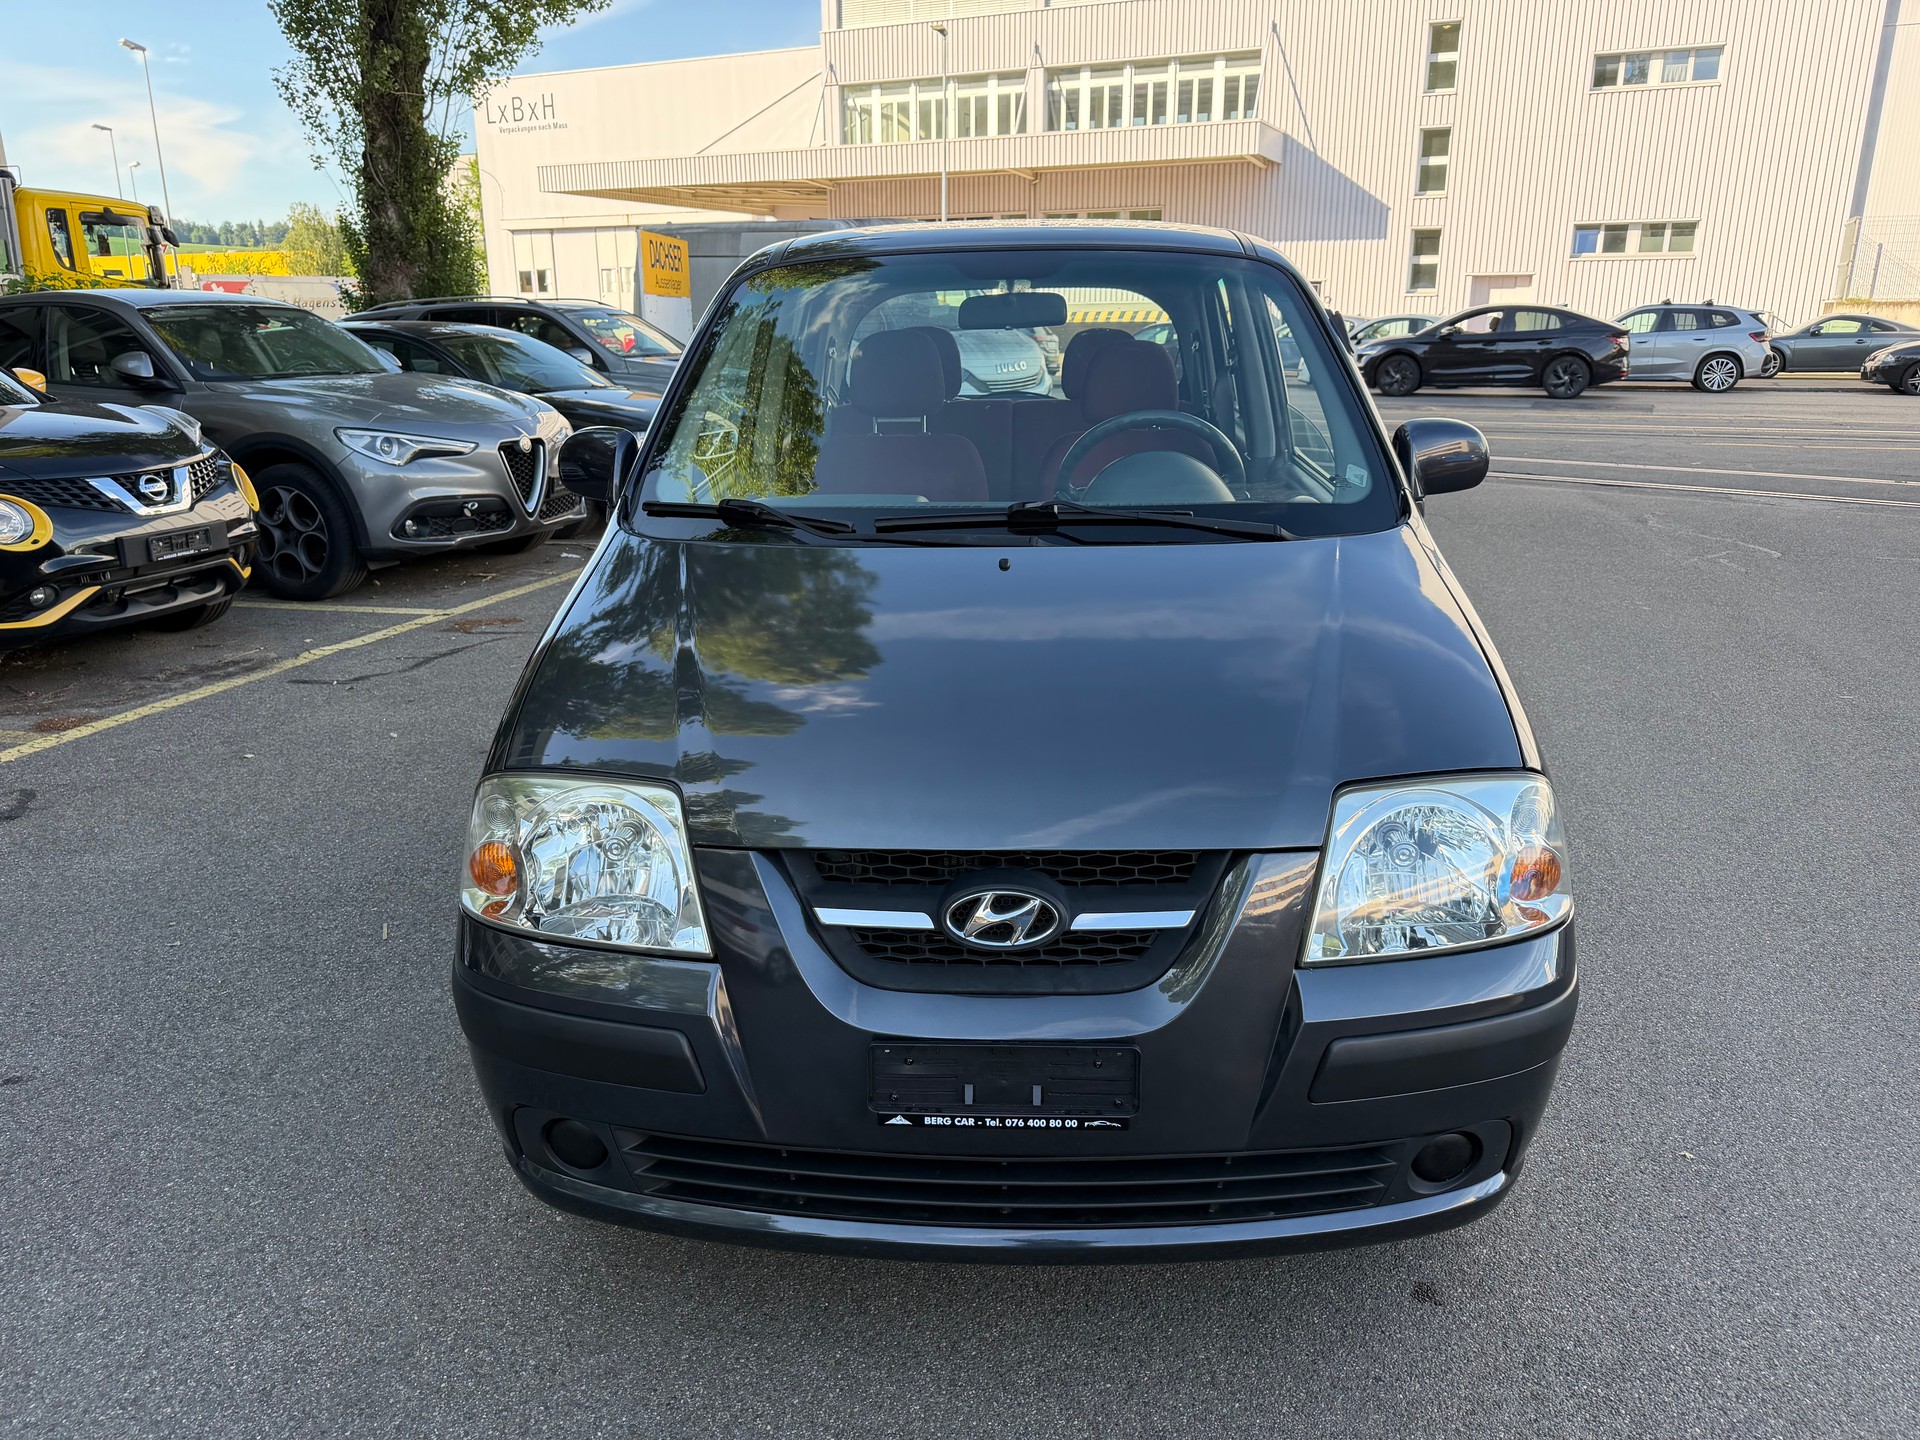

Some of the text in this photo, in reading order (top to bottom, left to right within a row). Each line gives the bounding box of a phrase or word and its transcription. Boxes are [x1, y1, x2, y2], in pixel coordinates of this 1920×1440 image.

[485, 92, 556, 125] LxBxH
[499, 122, 568, 134] Verpackungen nach Mass
[649, 239, 684, 273] DACHSER
[995, 360, 1028, 375] IVECO
[924, 1116, 952, 1126] BERG
[954, 1117, 975, 1126] CAR
[984, 1118, 1003, 1127] Tel.
[1005, 1118, 1025, 1127] 076
[1027, 1119, 1047, 1128] 400
[1049, 1119, 1062, 1128] 80
[1064, 1119, 1078, 1128] 00
